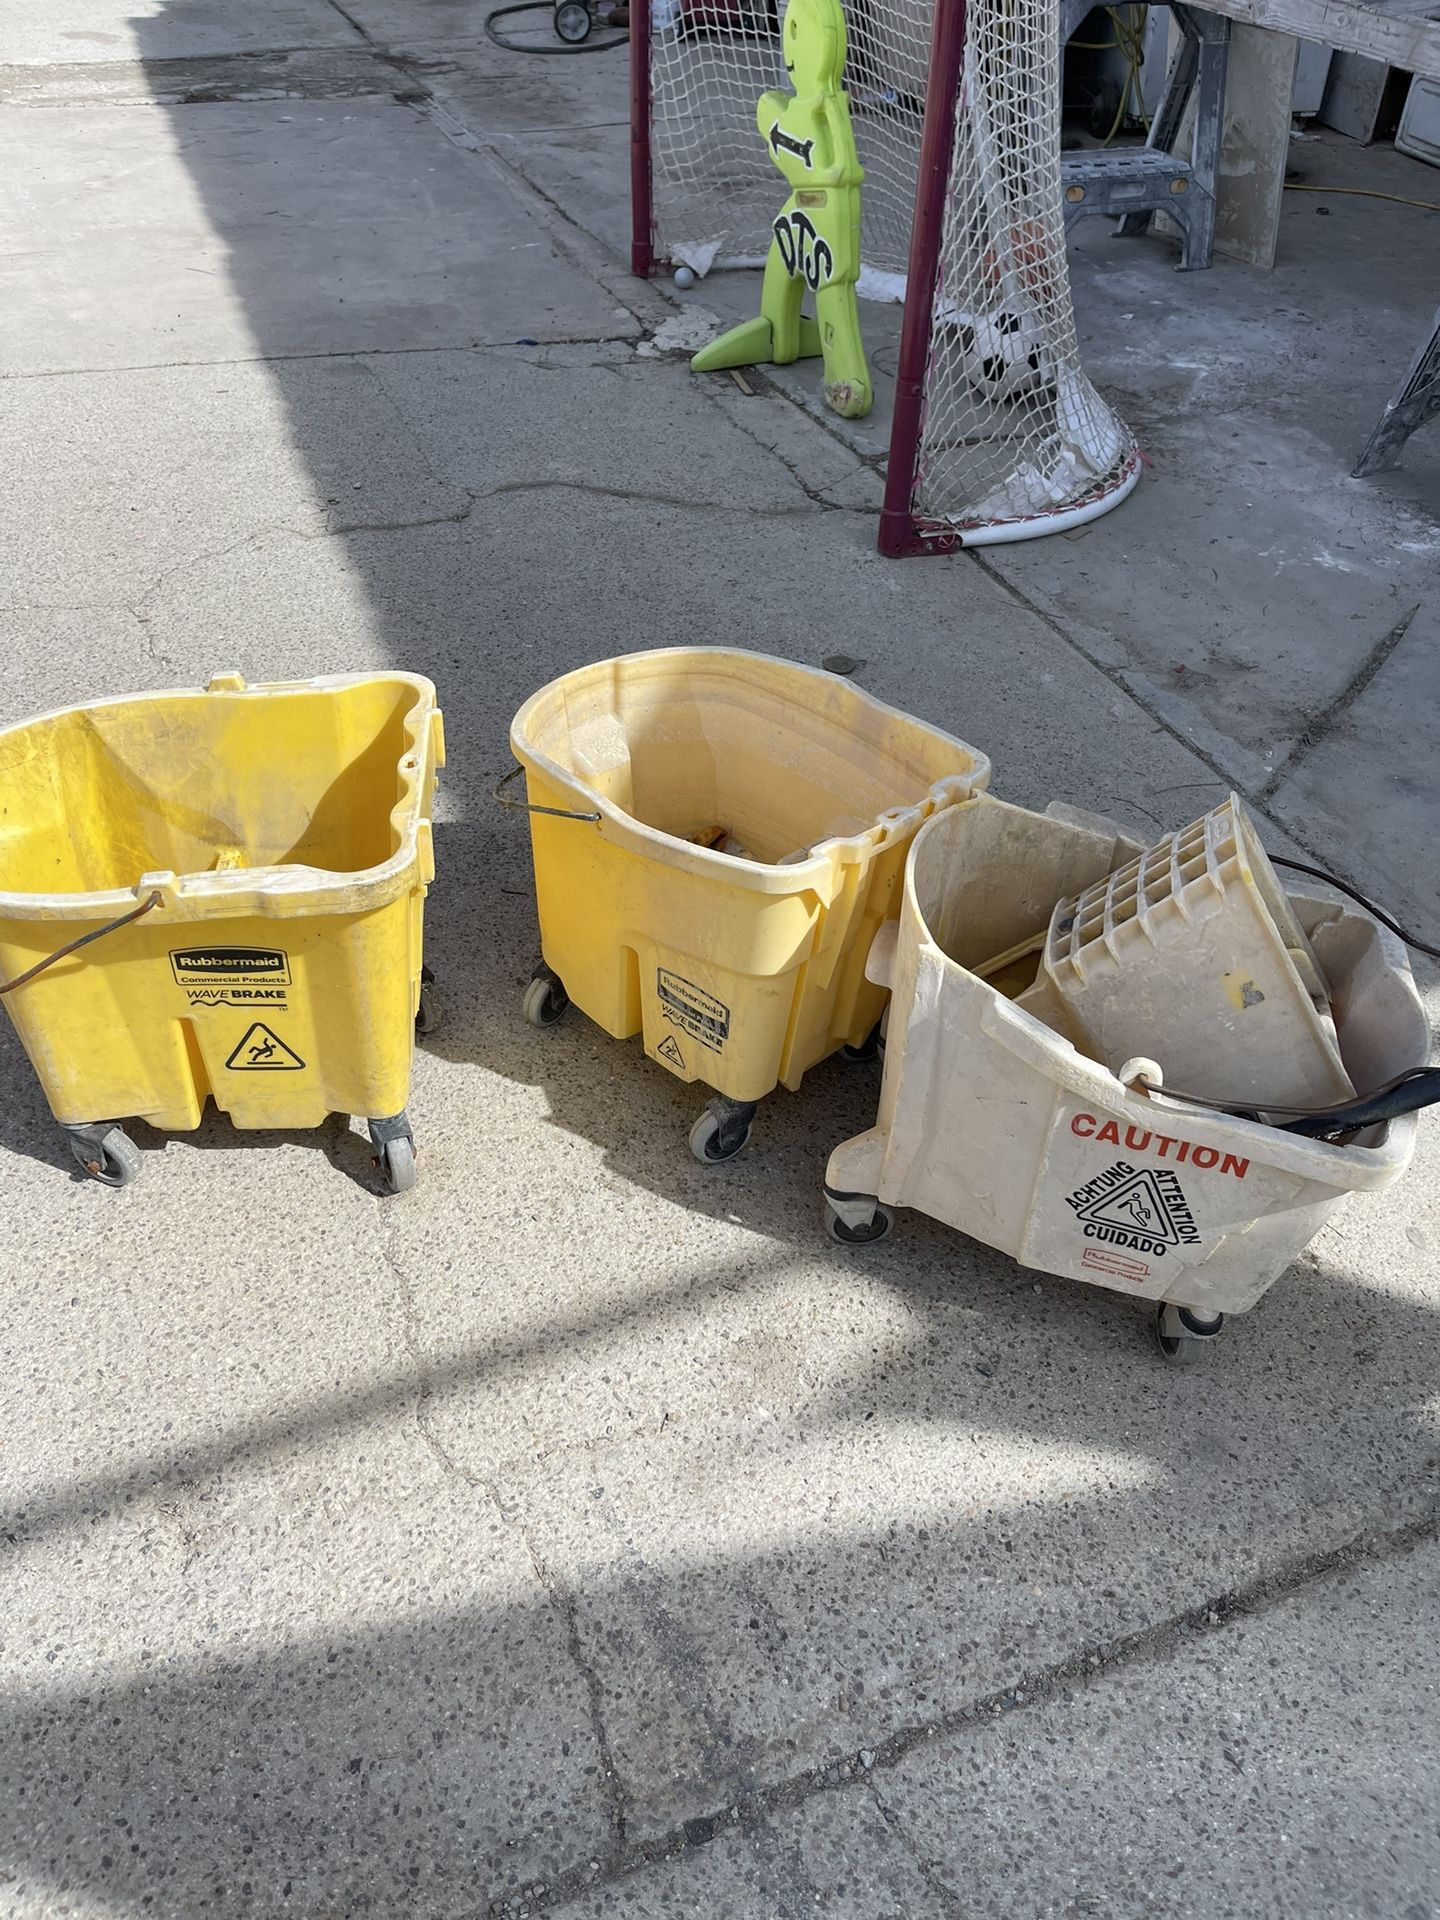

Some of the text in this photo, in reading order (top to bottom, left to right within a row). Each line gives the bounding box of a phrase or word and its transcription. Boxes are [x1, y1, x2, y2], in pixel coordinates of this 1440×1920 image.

[180, 957, 279, 967] Rubbermaid
[663, 976, 723, 1018] Rubbermaid
[1070, 1113, 1250, 1179] CAUTION
[1065, 1160, 1136, 1211] ACHTUNG
[1153, 1169, 1202, 1244] ATTENTION
[1083, 1223, 1167, 1257] CUIDADO
[1087, 1251, 1144, 1272] Rubbermaid
[1117, 1271, 1144, 1283] Products
